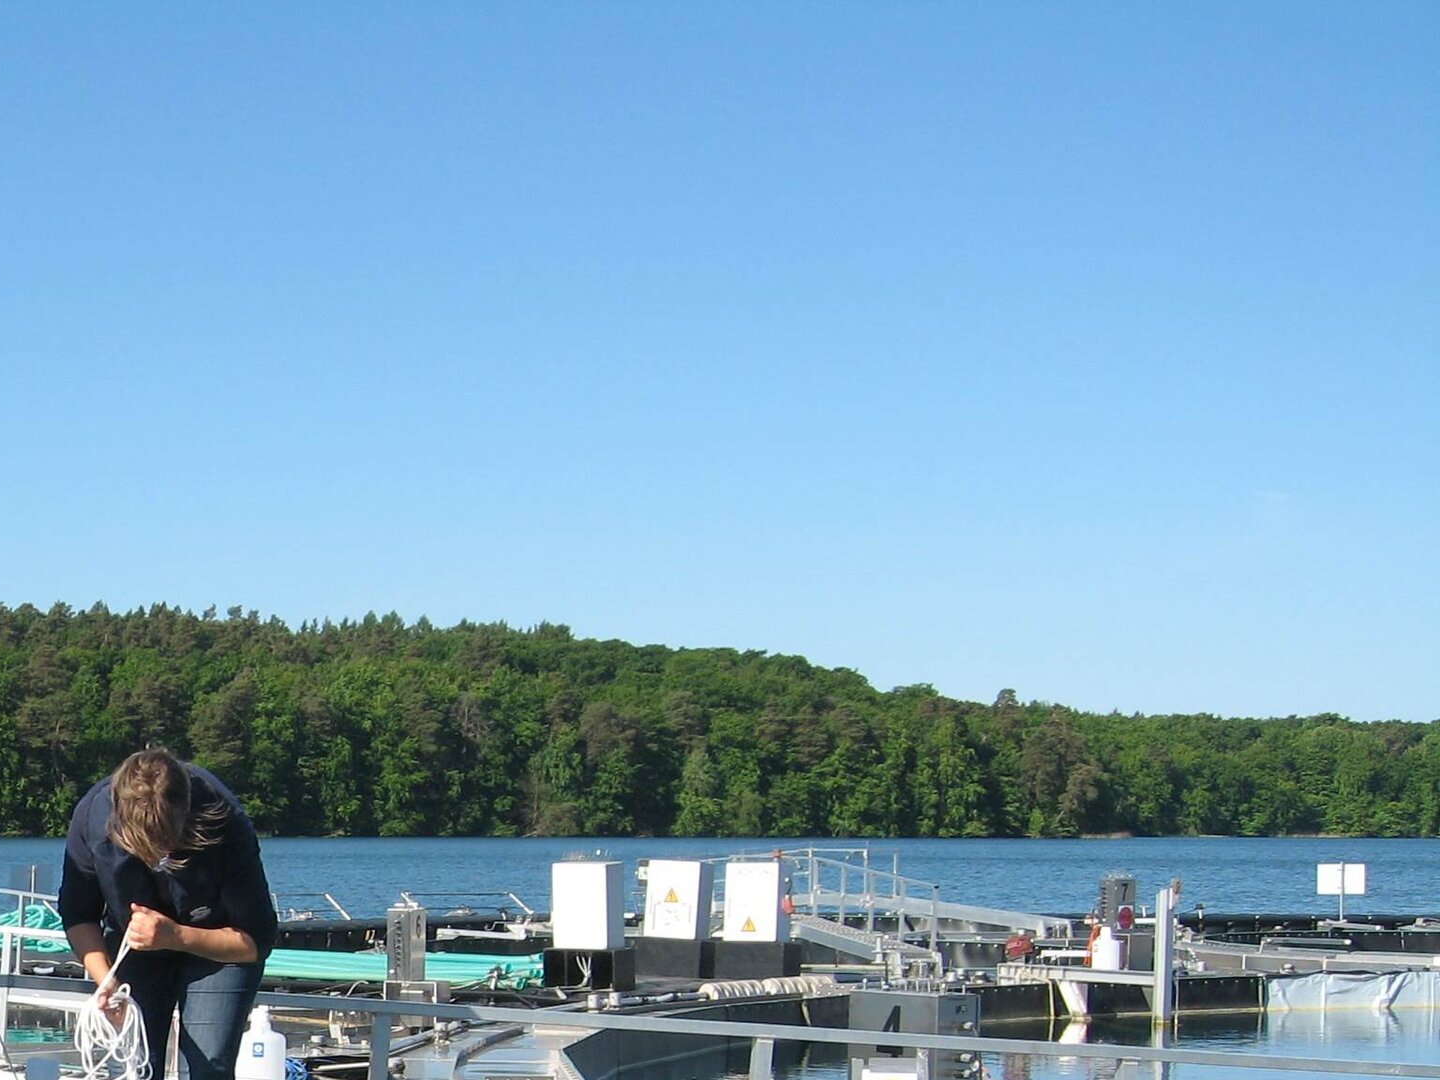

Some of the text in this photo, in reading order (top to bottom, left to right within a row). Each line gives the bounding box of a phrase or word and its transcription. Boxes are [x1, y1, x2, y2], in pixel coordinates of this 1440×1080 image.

[1121, 883, 1129, 902] 7
[415, 914, 422, 939] 6
[875, 1005, 904, 1058] 4
